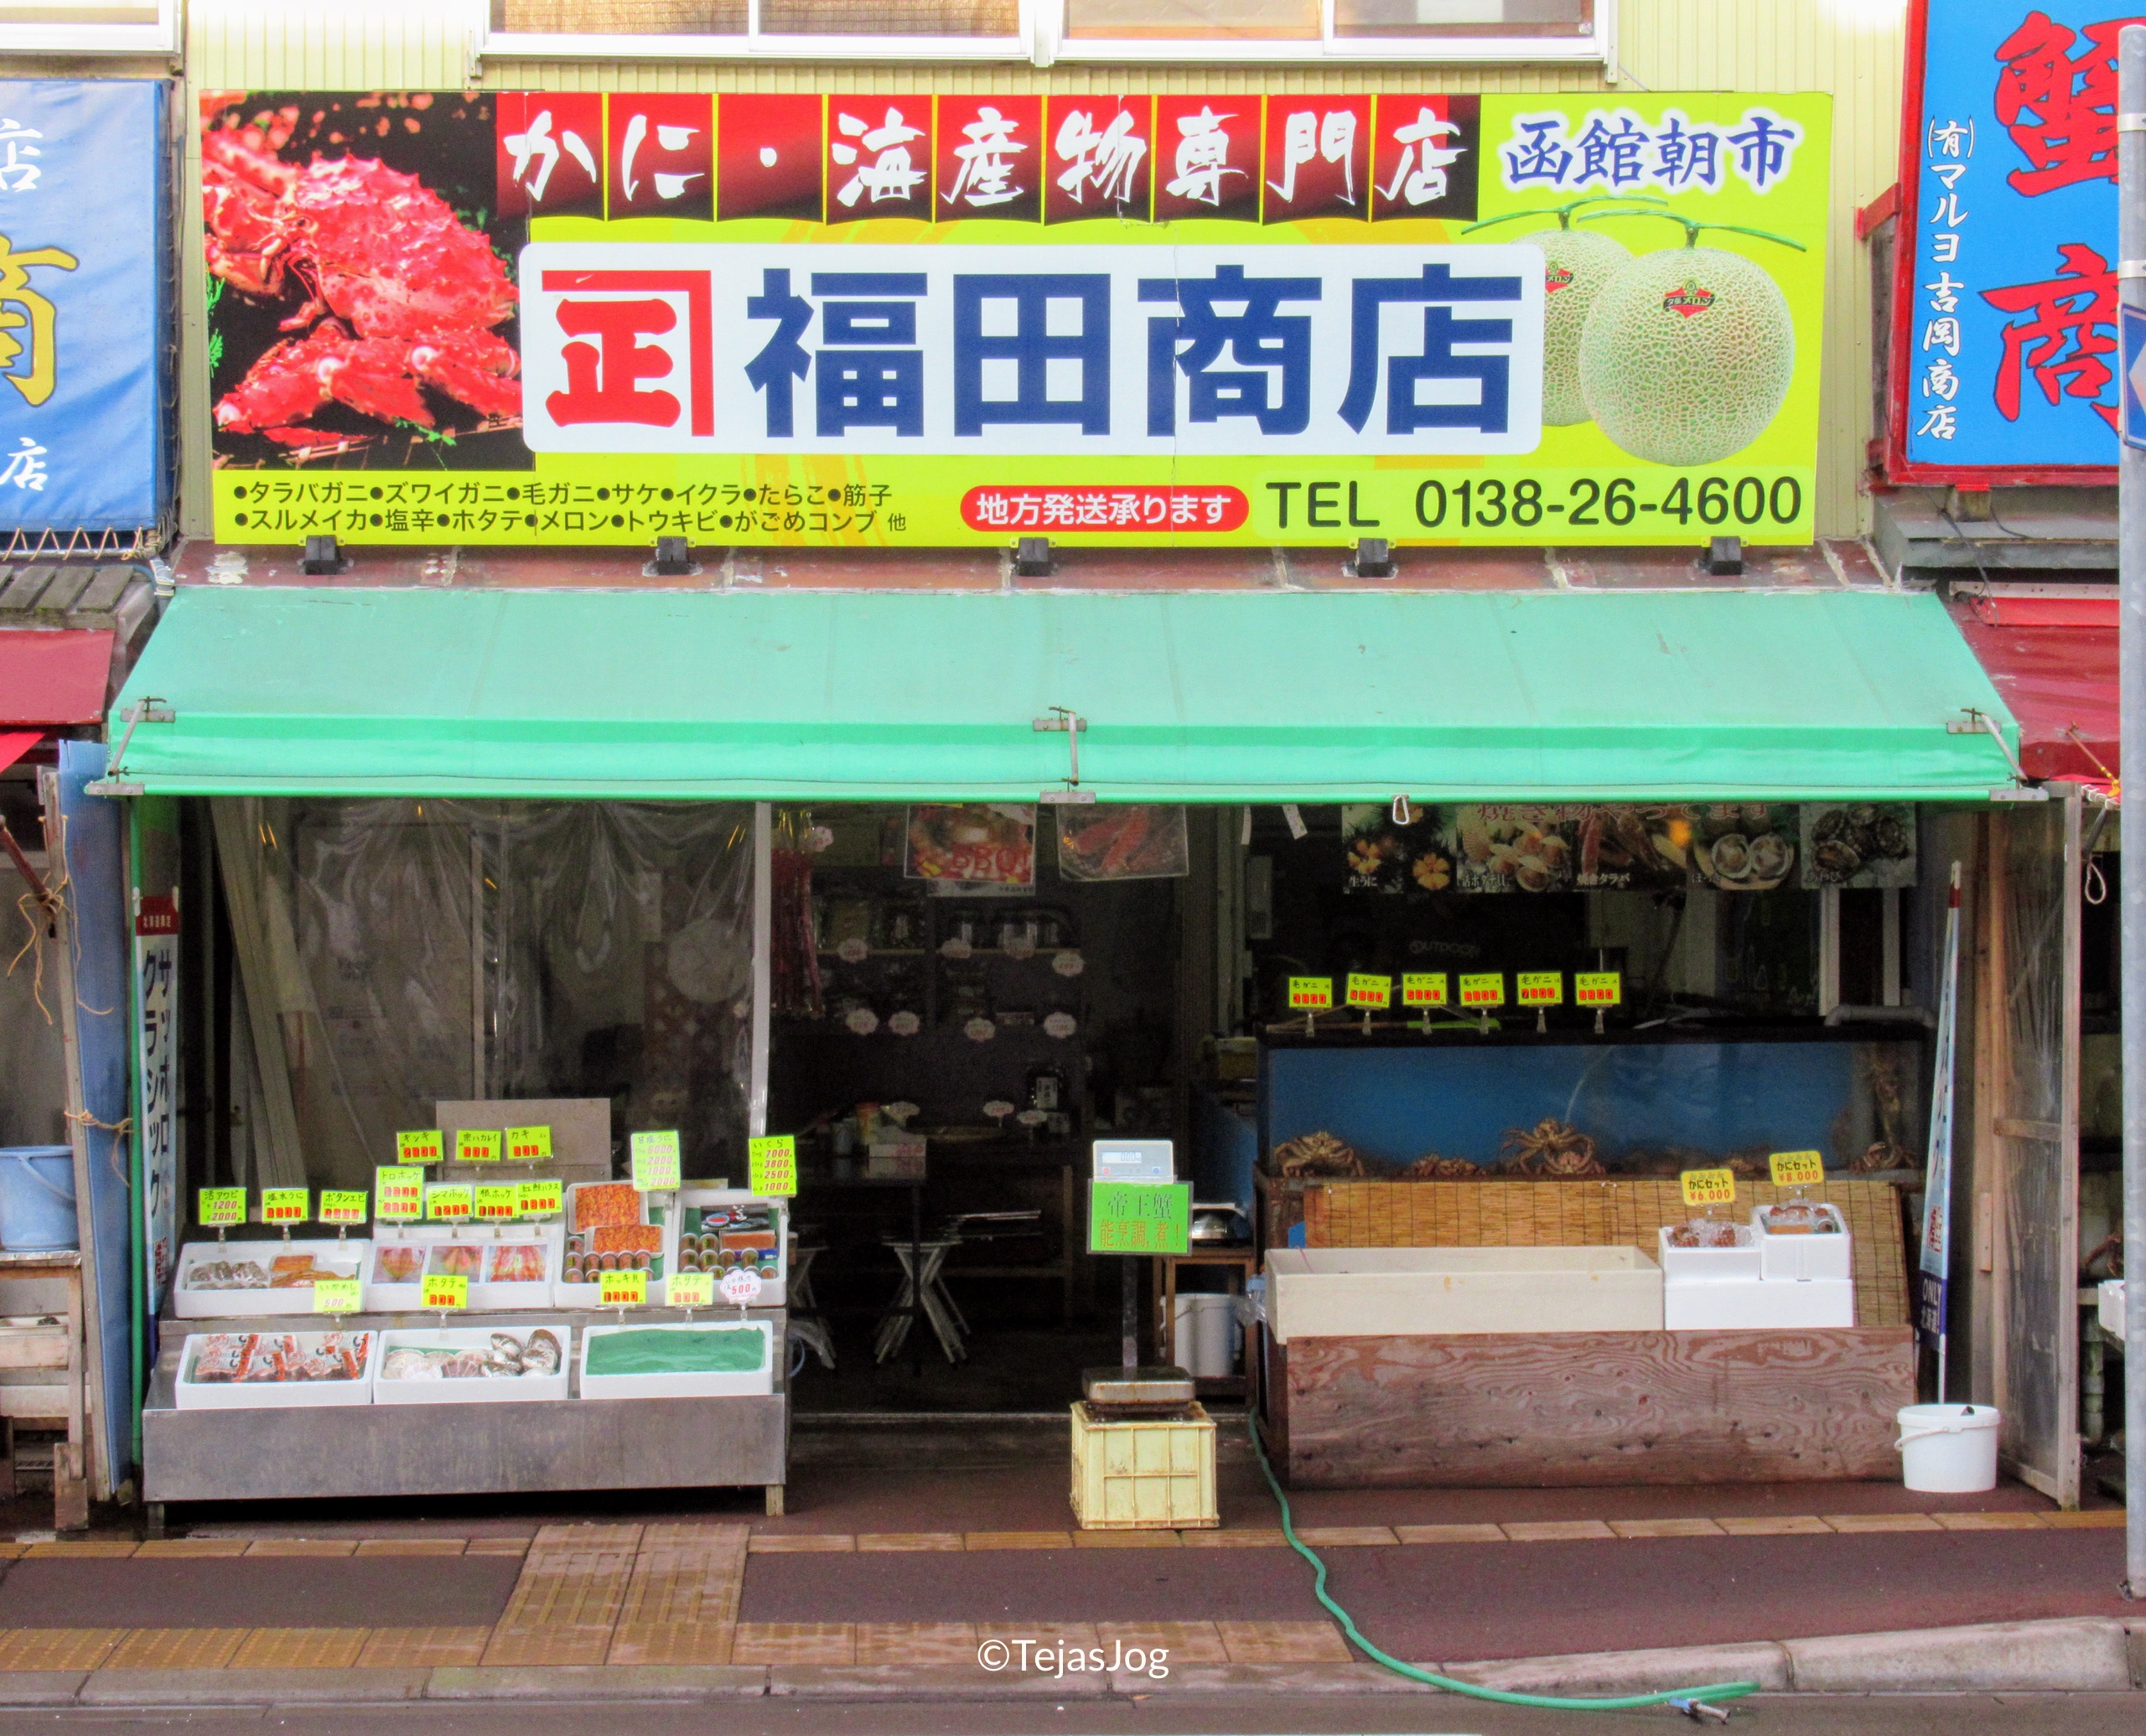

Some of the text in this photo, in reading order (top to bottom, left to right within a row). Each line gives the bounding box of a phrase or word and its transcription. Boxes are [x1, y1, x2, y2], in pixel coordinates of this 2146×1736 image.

[505, 106, 1467, 207] かに・海産物専門店
[1507, 116, 1796, 189] 函館朝市
[744, 263, 1522, 438] 福田商店
[250, 481, 892, 506] タラバガニ ズワイガニ 毛ガニ サケ イクラ たらこ 筋子
[1266, 476, 1801, 528] TEL 0138-26-4600
[977, 492, 1231, 526] 地方発送承ります
[251, 509, 906, 532] スルメイカ 塩辛 ホタテ メロン トウキビ がごめコンブ 他
[754, 1138, 783, 1148] いくら
[765, 1148, 790, 1158] 7000
[765, 1159, 789, 1168] 3800
[1777, 1158, 1817, 1172] かにセット
[764, 1169, 789, 1179] 2500
[765, 1182, 788, 1191] 1000
[1688, 1178, 1728, 1189] かにセット
[325, 1192, 365, 1202] ボタンエビ
[432, 1188, 470, 1199] シマホッケ
[214, 1200, 237, 1209] 1200
[212, 1212, 236, 1220] 2000
[428, 1277, 457, 1288] ホタテ
[672, 1276, 702, 1286] ホタテ
[732, 1284, 751, 1294] 500
